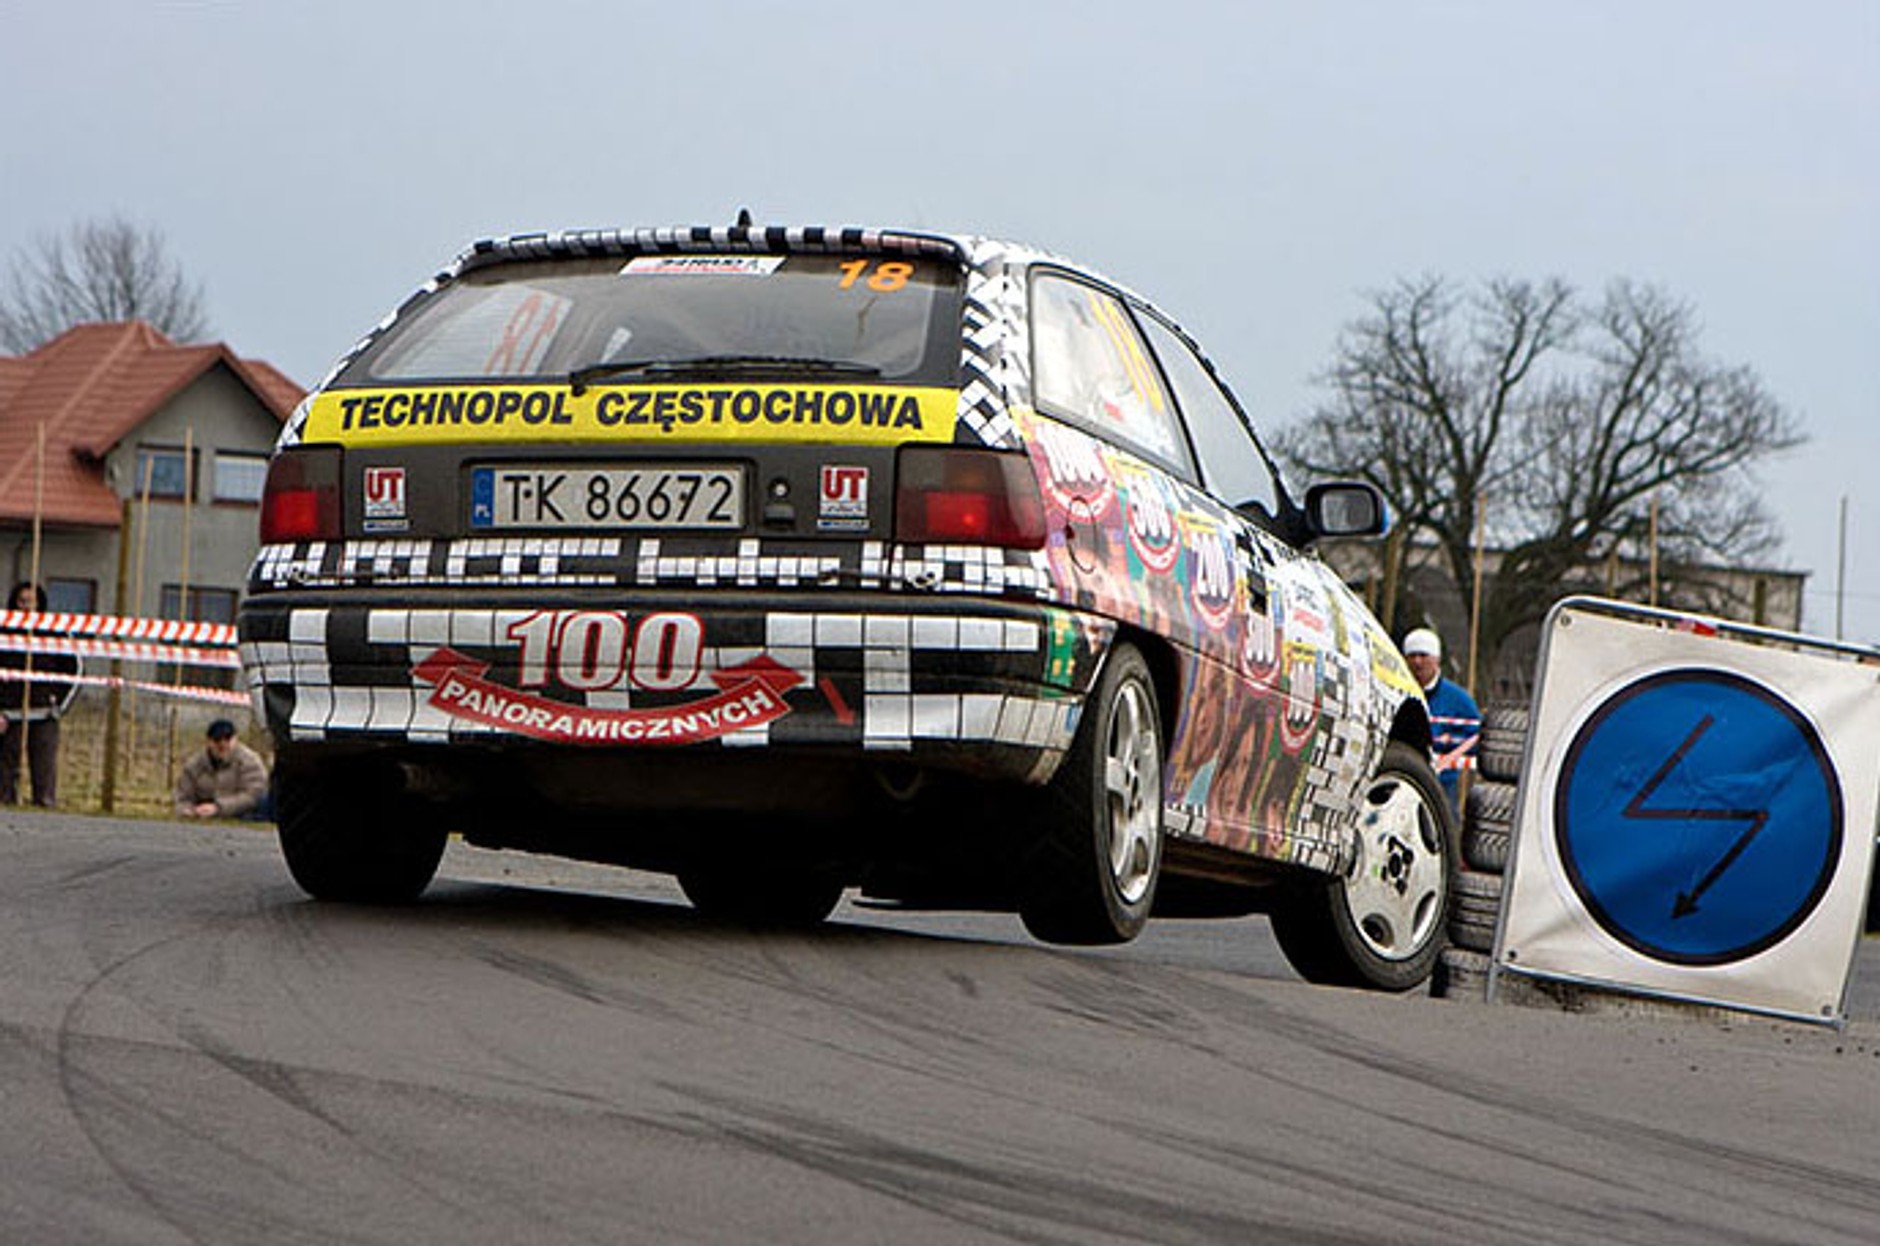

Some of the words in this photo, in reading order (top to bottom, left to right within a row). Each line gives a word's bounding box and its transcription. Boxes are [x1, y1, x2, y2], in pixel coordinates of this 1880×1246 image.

[838, 259, 914, 291] 18
[340, 391, 573, 430] TECHNOPOL
[596, 391, 923, 432] CZĘSTOCHOWA
[367, 469, 403, 501] UT
[503, 475, 567, 521] TK
[586, 474, 732, 522] 86672
[823, 465, 865, 500] UT
[506, 609, 704, 691] 100
[440, 679, 775, 740] PANORAMICZNYCH
